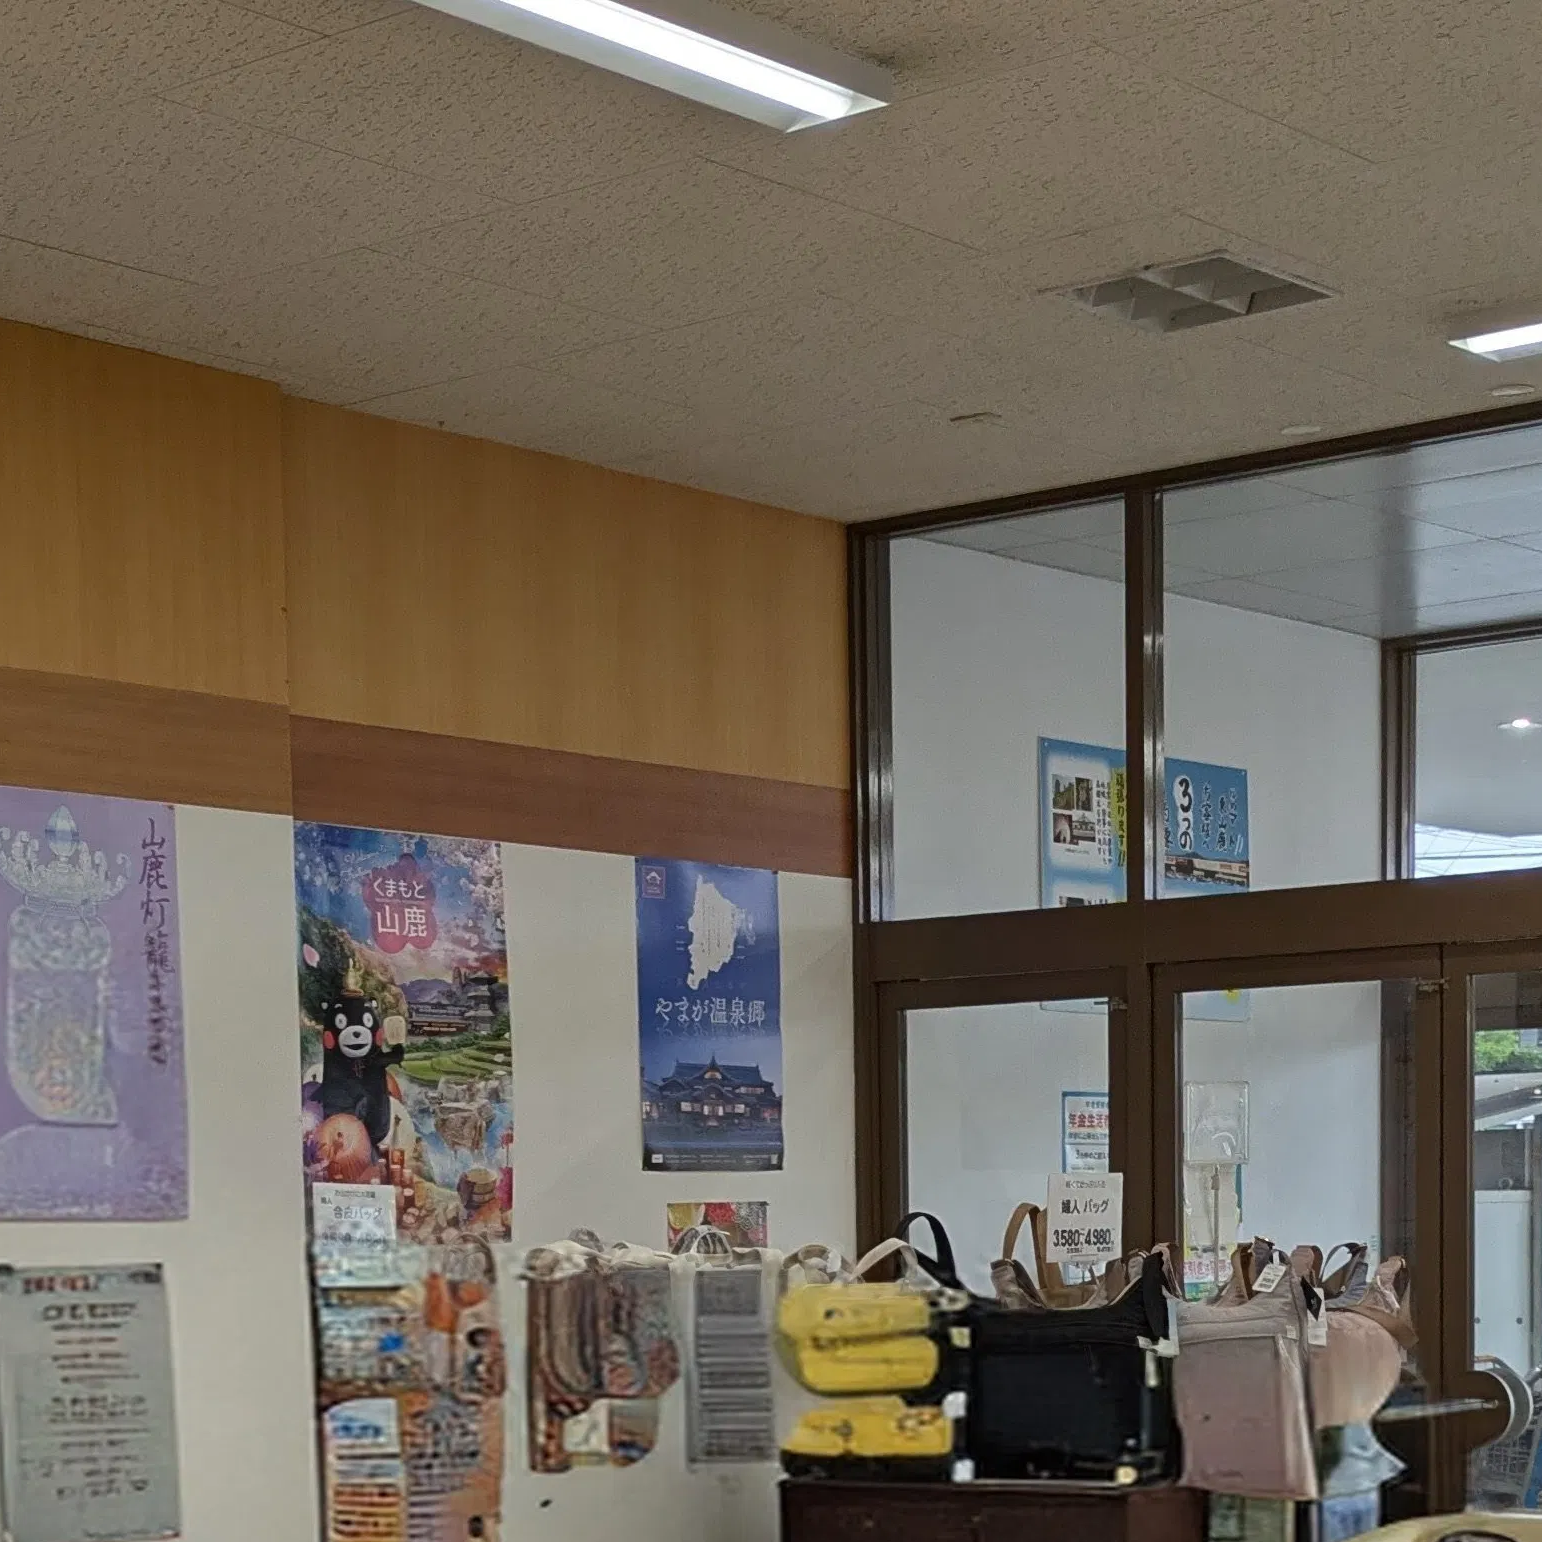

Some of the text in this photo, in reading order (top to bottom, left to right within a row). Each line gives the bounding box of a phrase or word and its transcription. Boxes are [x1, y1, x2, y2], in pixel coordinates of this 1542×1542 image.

[373, 877, 426, 899] くまもと
[376, 904, 427, 937] 山鹿
[655, 996, 765, 1026] やまが温泉郷
[1083, 1197, 1110, 1214] バッグ
